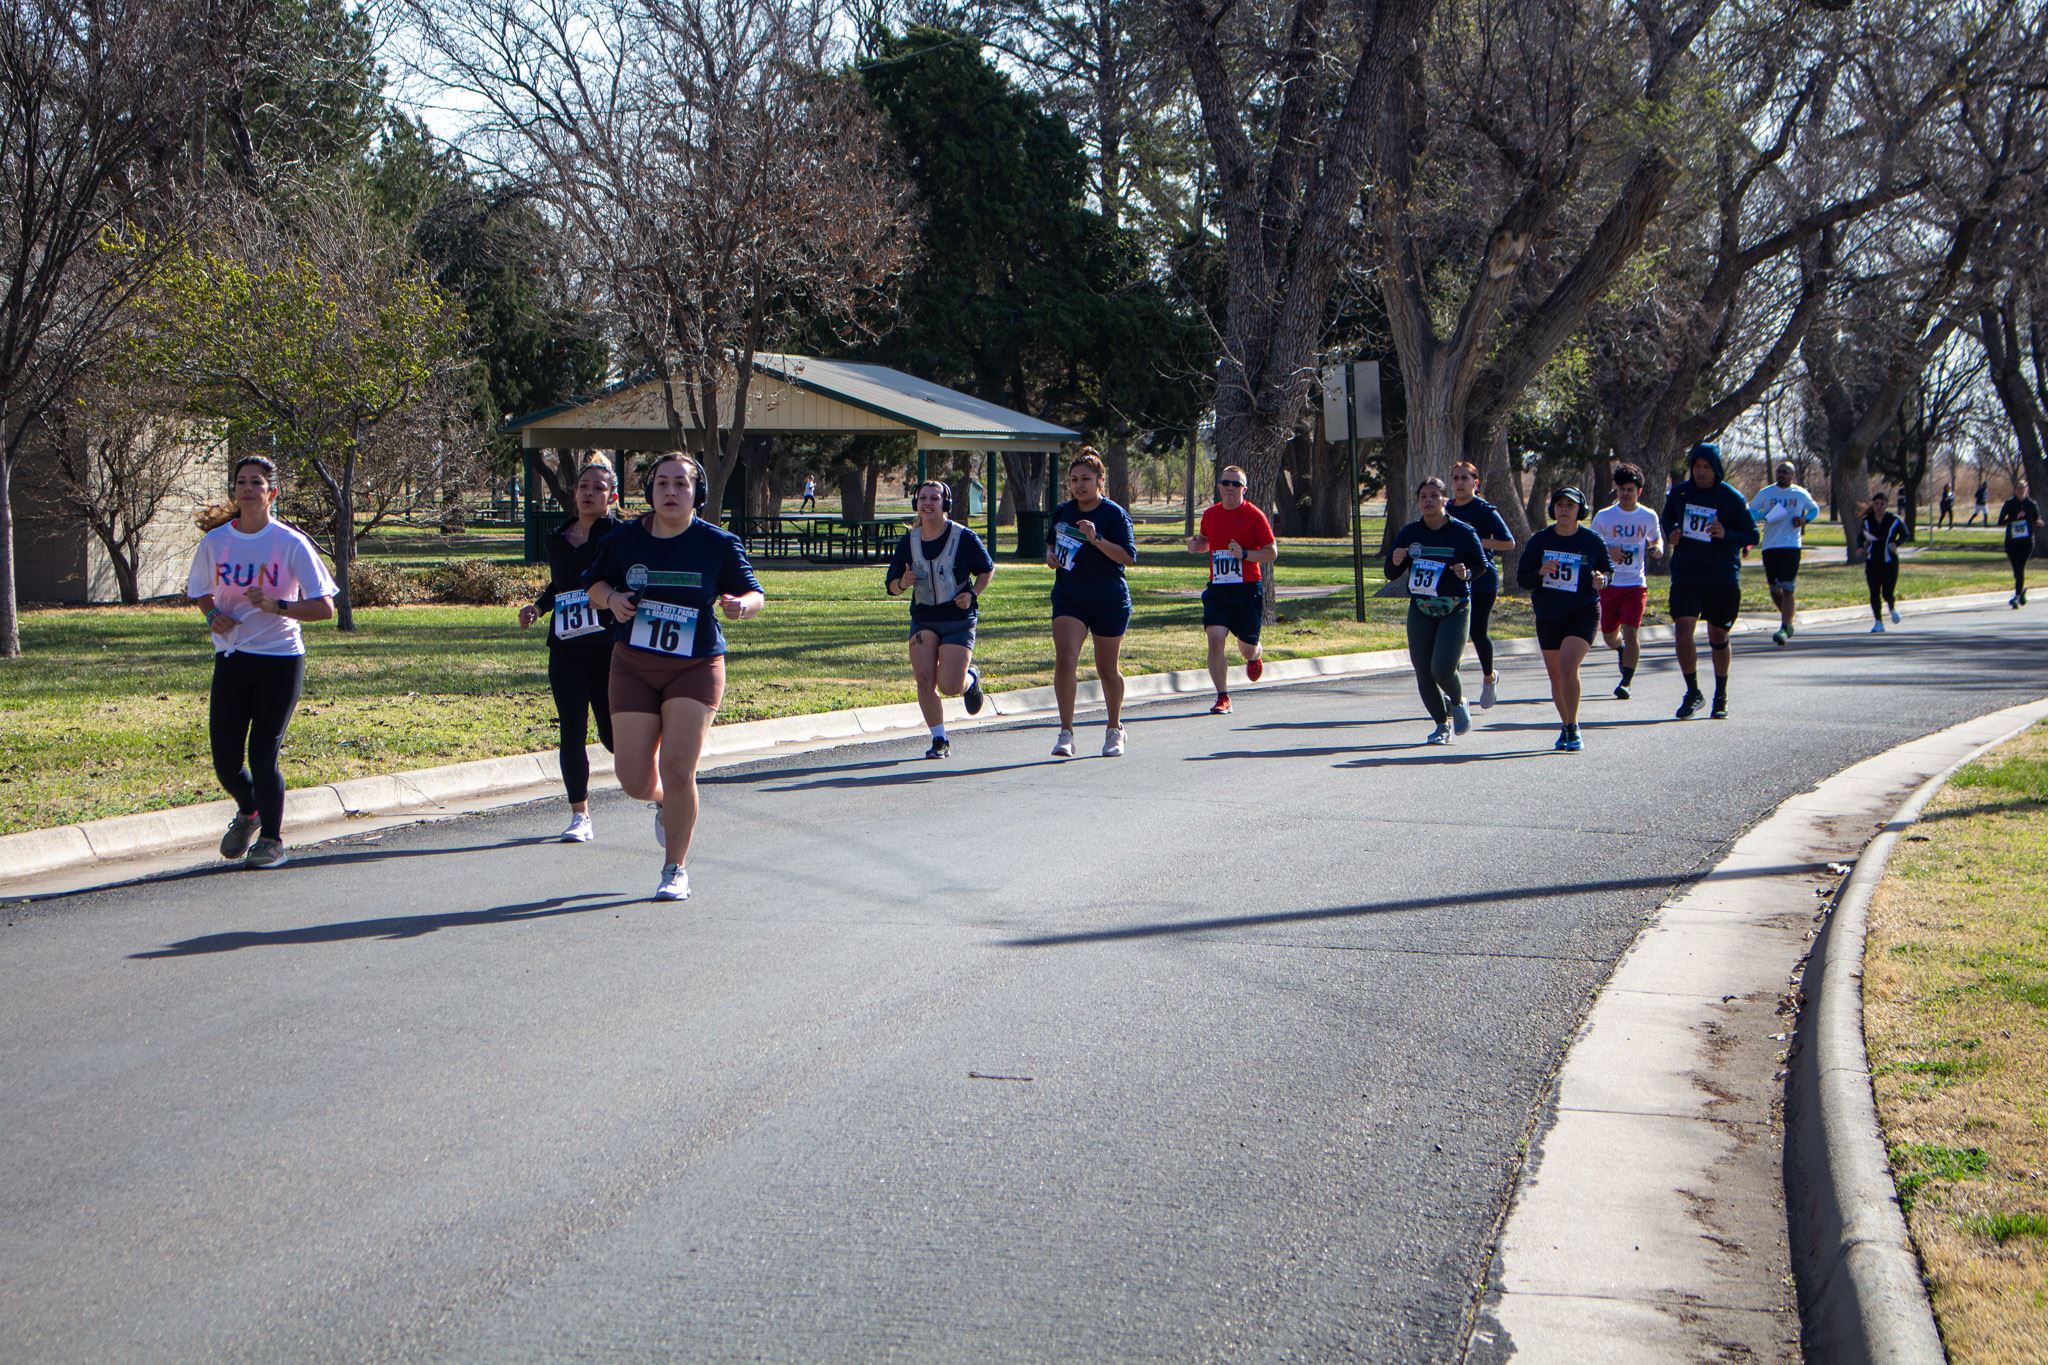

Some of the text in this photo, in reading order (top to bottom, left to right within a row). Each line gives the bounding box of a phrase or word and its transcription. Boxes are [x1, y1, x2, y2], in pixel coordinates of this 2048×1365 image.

[1612, 524, 1647, 538] RUN
[1690, 514, 1708, 532] 87
[215, 563, 279, 587] RUN
[1213, 558, 1241, 576] 104
[1414, 568, 1434, 588] 53
[559, 603, 595, 631] 131
[638, 601, 699, 618] GARDEN CITY PARKS
[651, 610, 688, 623] RECREATION
[647, 618, 681, 652] 16
